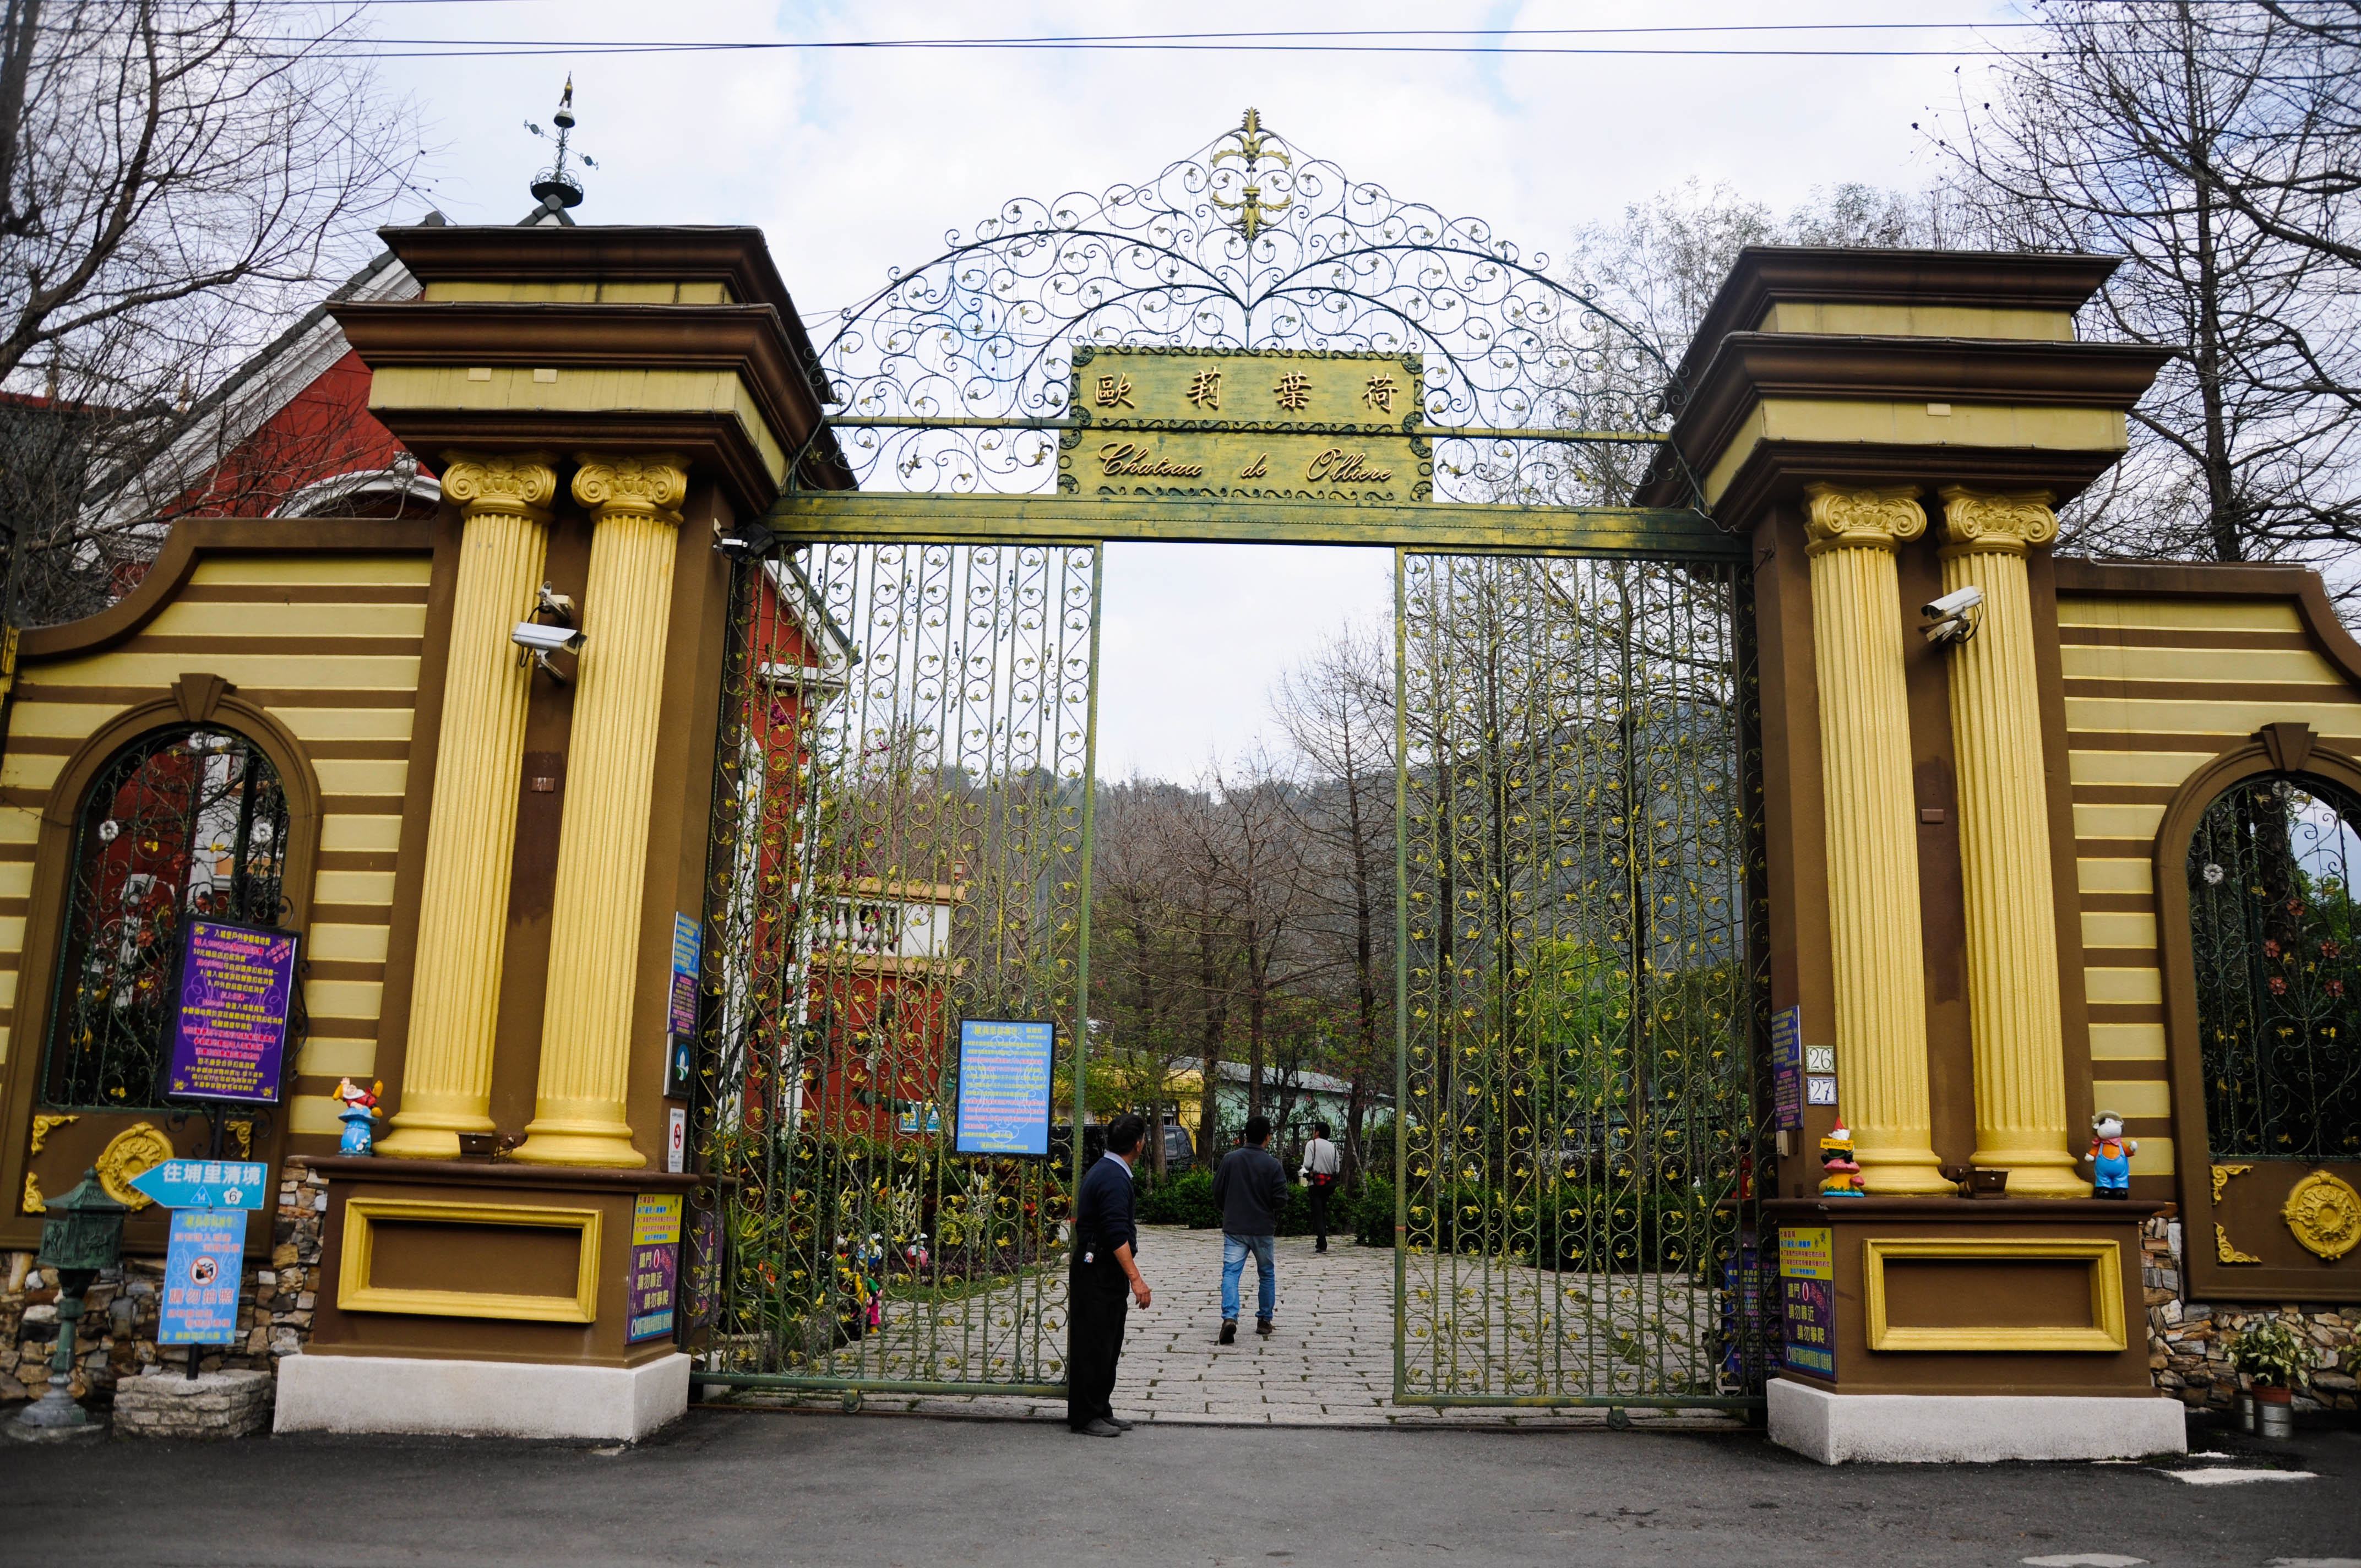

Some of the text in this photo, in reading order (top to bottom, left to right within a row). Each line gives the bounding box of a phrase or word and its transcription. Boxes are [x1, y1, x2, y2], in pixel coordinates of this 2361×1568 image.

[1098, 442, 1392, 483] Chateau de Olliere
[1809, 1047, 1832, 1070] 26
[1811, 1079, 1833, 1101] 27
[1822, 1140, 1852, 1148] WELCOME
[163, 1162, 262, 1185] 往埔里清境
[197, 1193, 206, 1202] 14
[229, 1190, 237, 1202] 6
